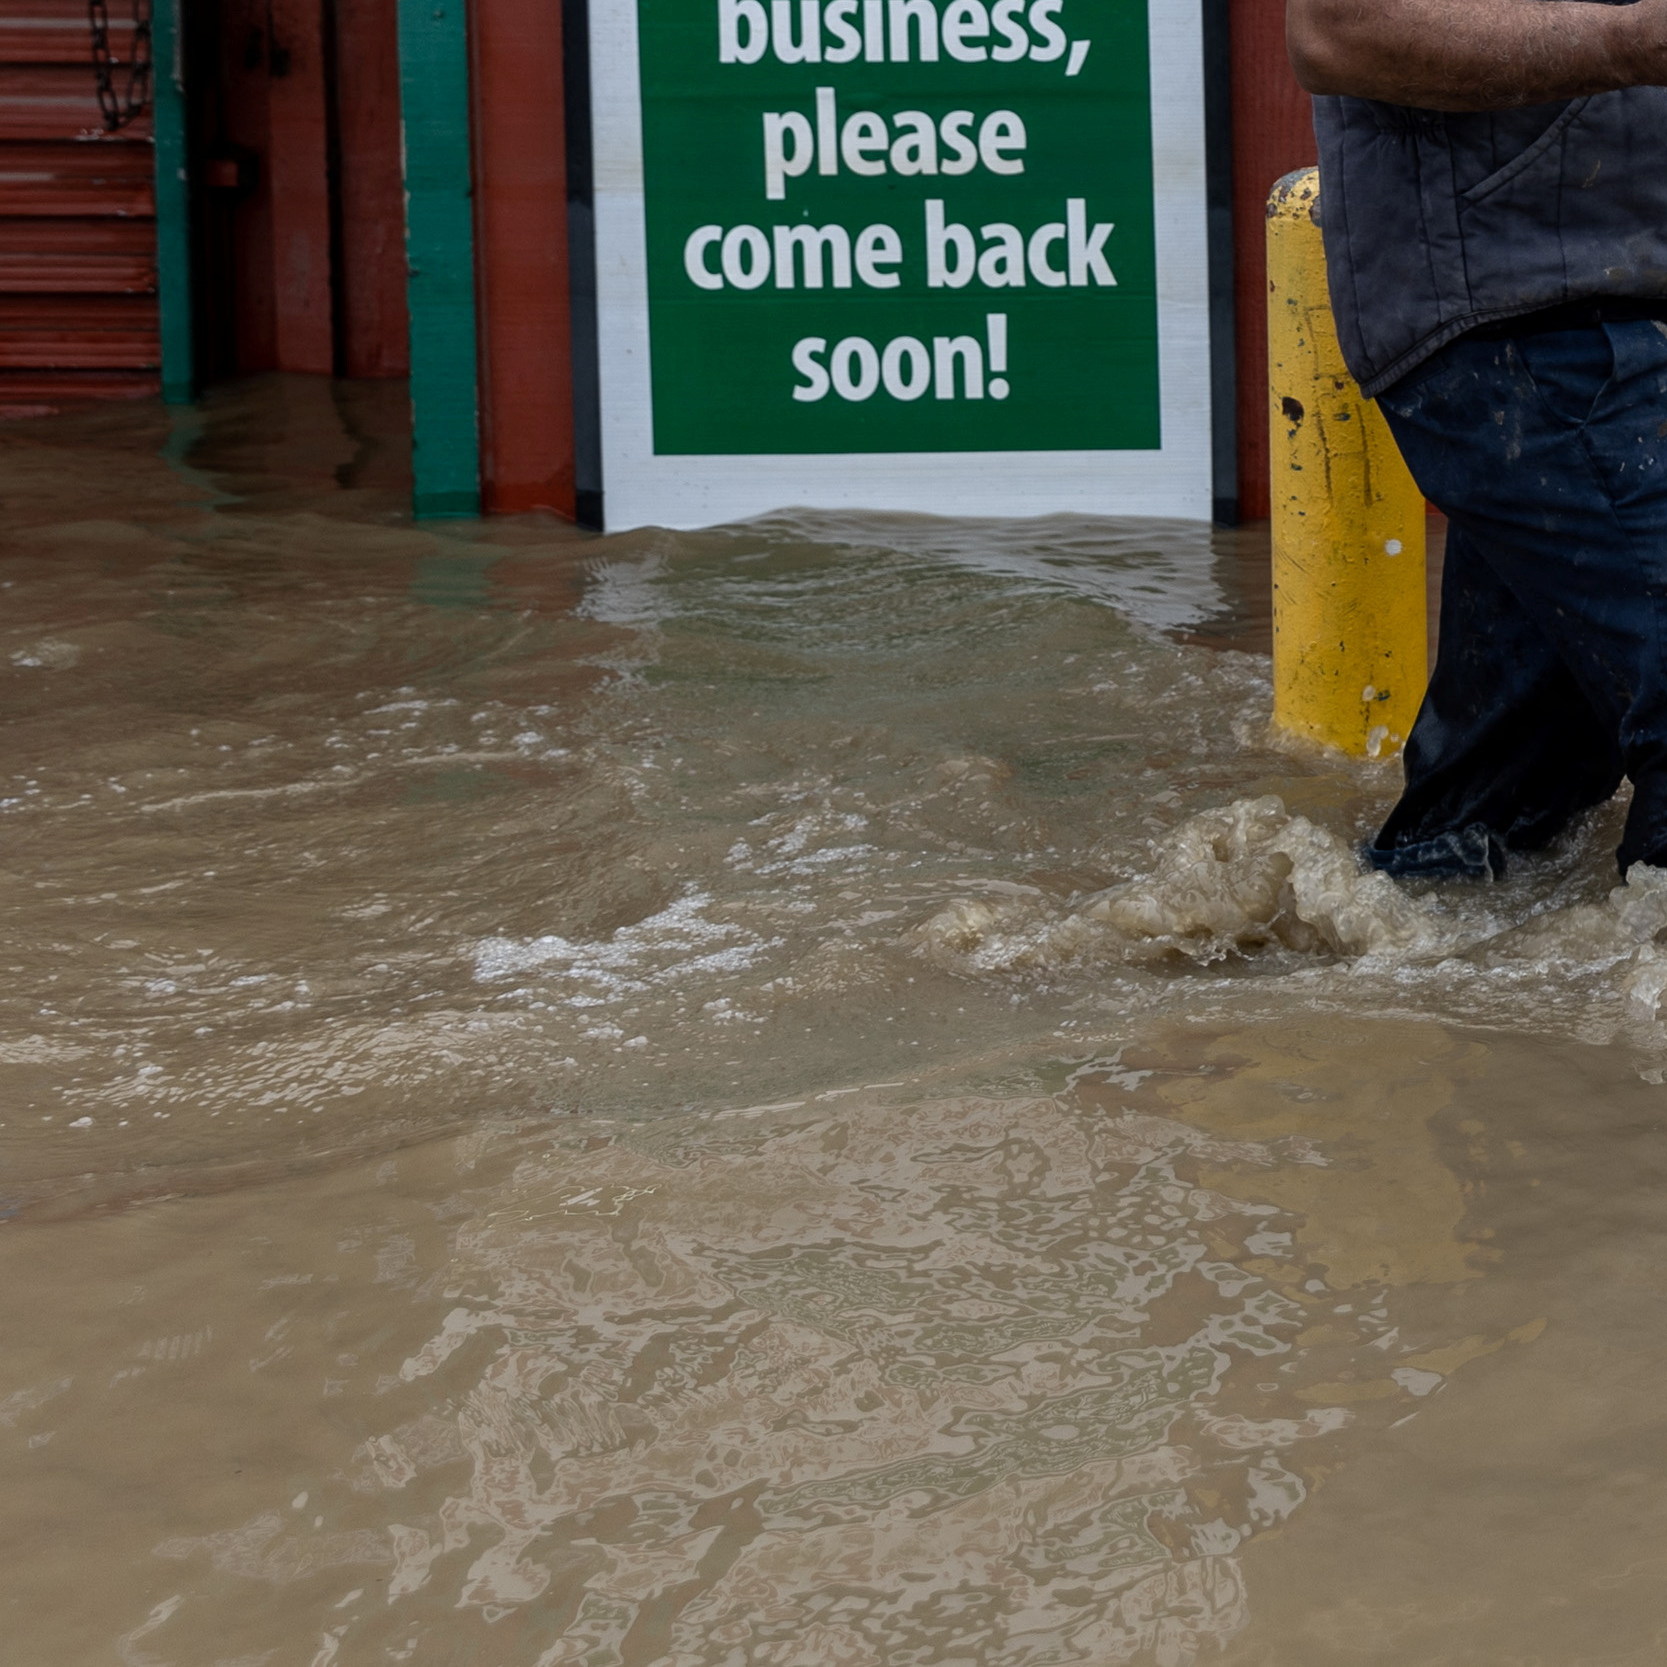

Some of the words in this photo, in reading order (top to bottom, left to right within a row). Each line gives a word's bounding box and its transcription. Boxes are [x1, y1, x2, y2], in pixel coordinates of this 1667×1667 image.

[763, 87, 1026, 200] please
[684, 224, 902, 289] come
[925, 198, 1117, 288] back
[792, 313, 1009, 401] soon!
